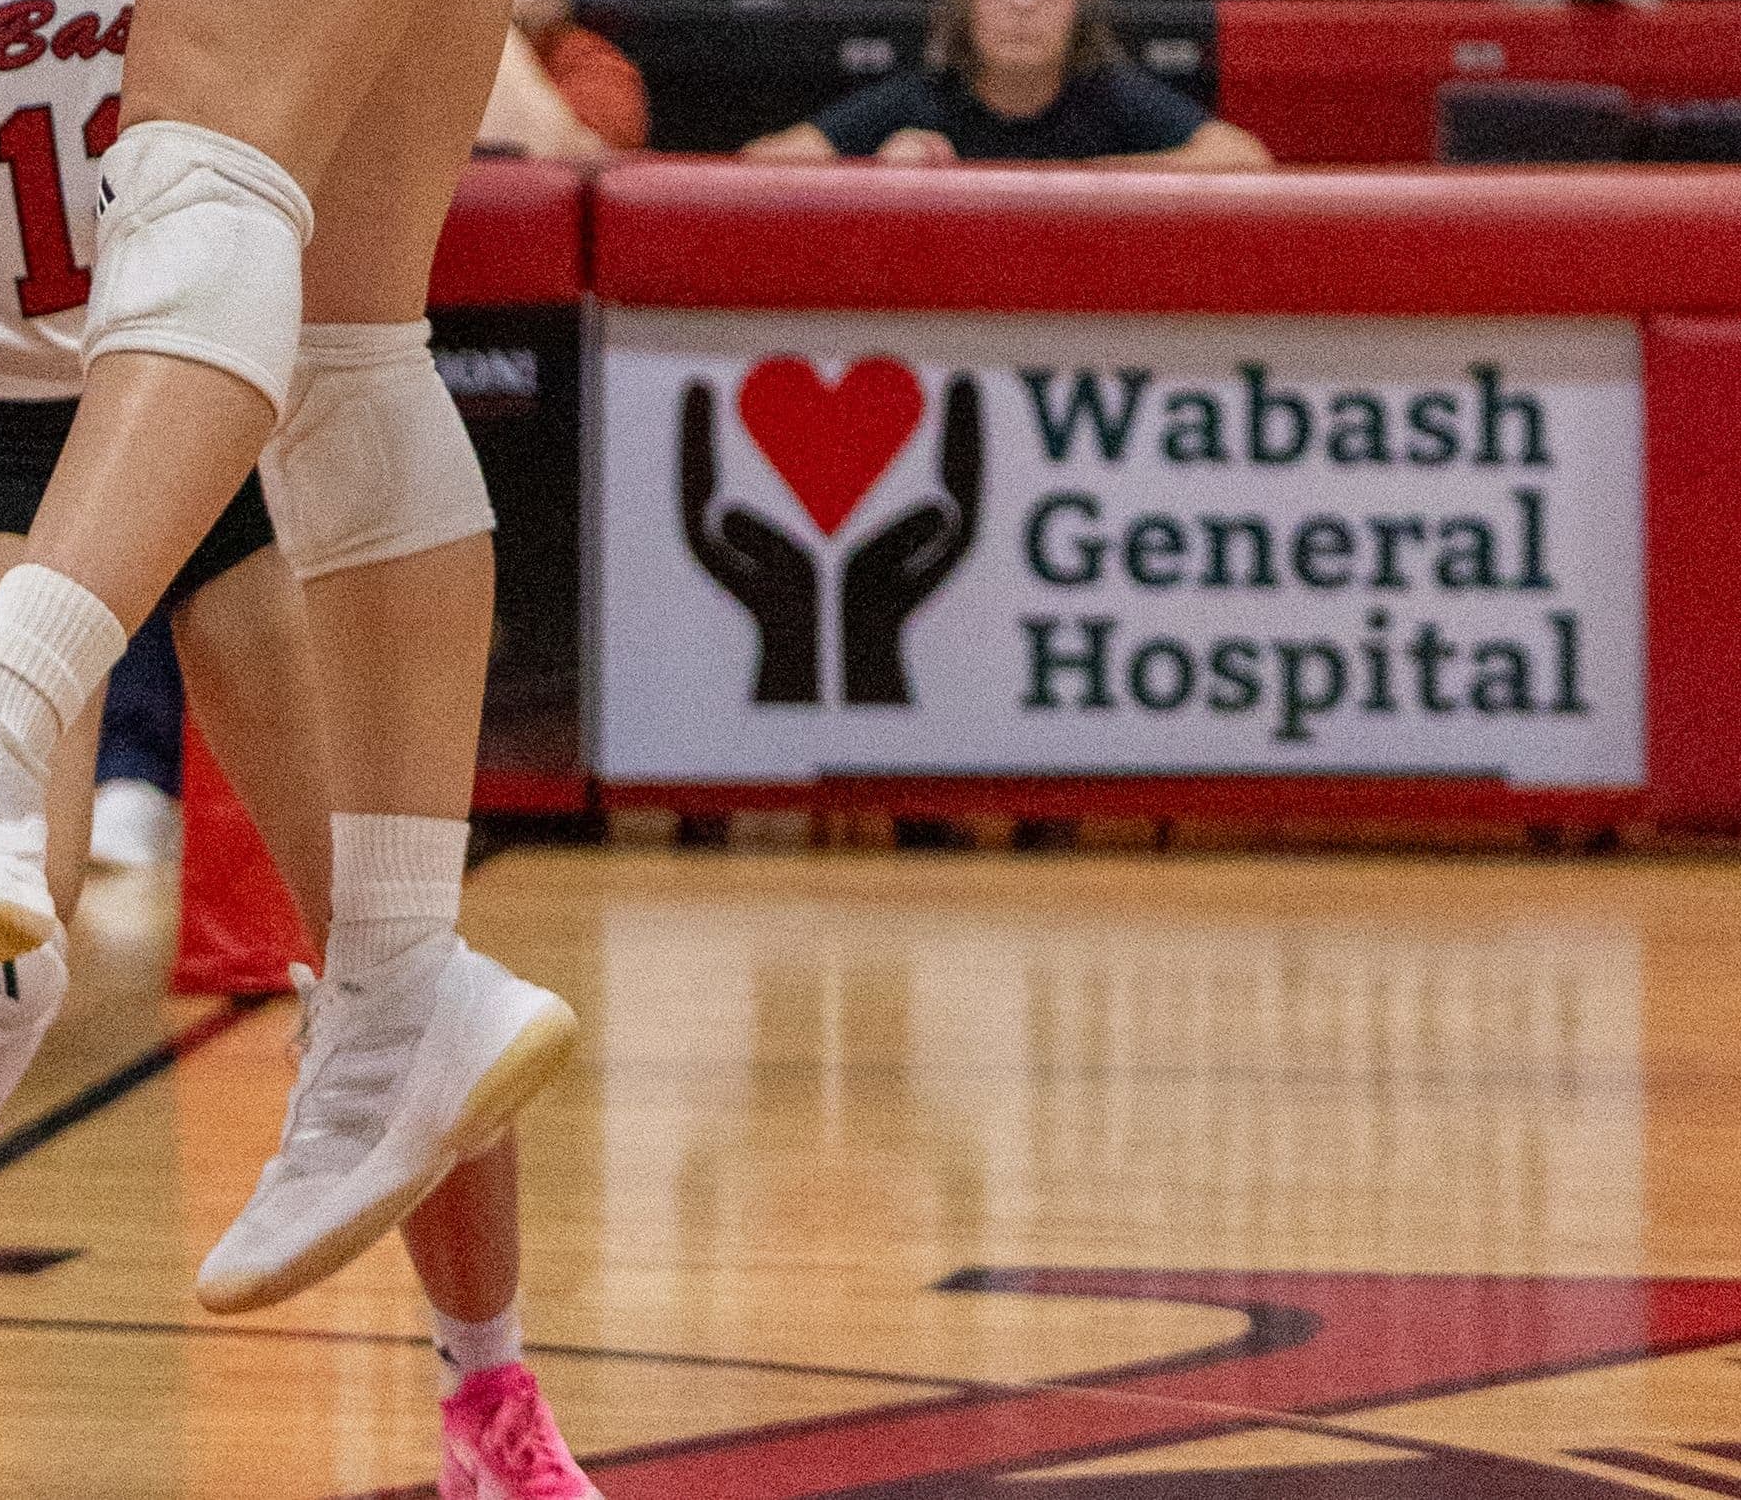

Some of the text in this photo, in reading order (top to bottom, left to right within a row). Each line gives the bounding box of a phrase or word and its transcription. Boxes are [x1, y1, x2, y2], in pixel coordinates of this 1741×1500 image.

[1017, 361, 1553, 469] Wabash
[1022, 488, 1555, 592] General
[1018, 608, 1590, 744] Hospital
